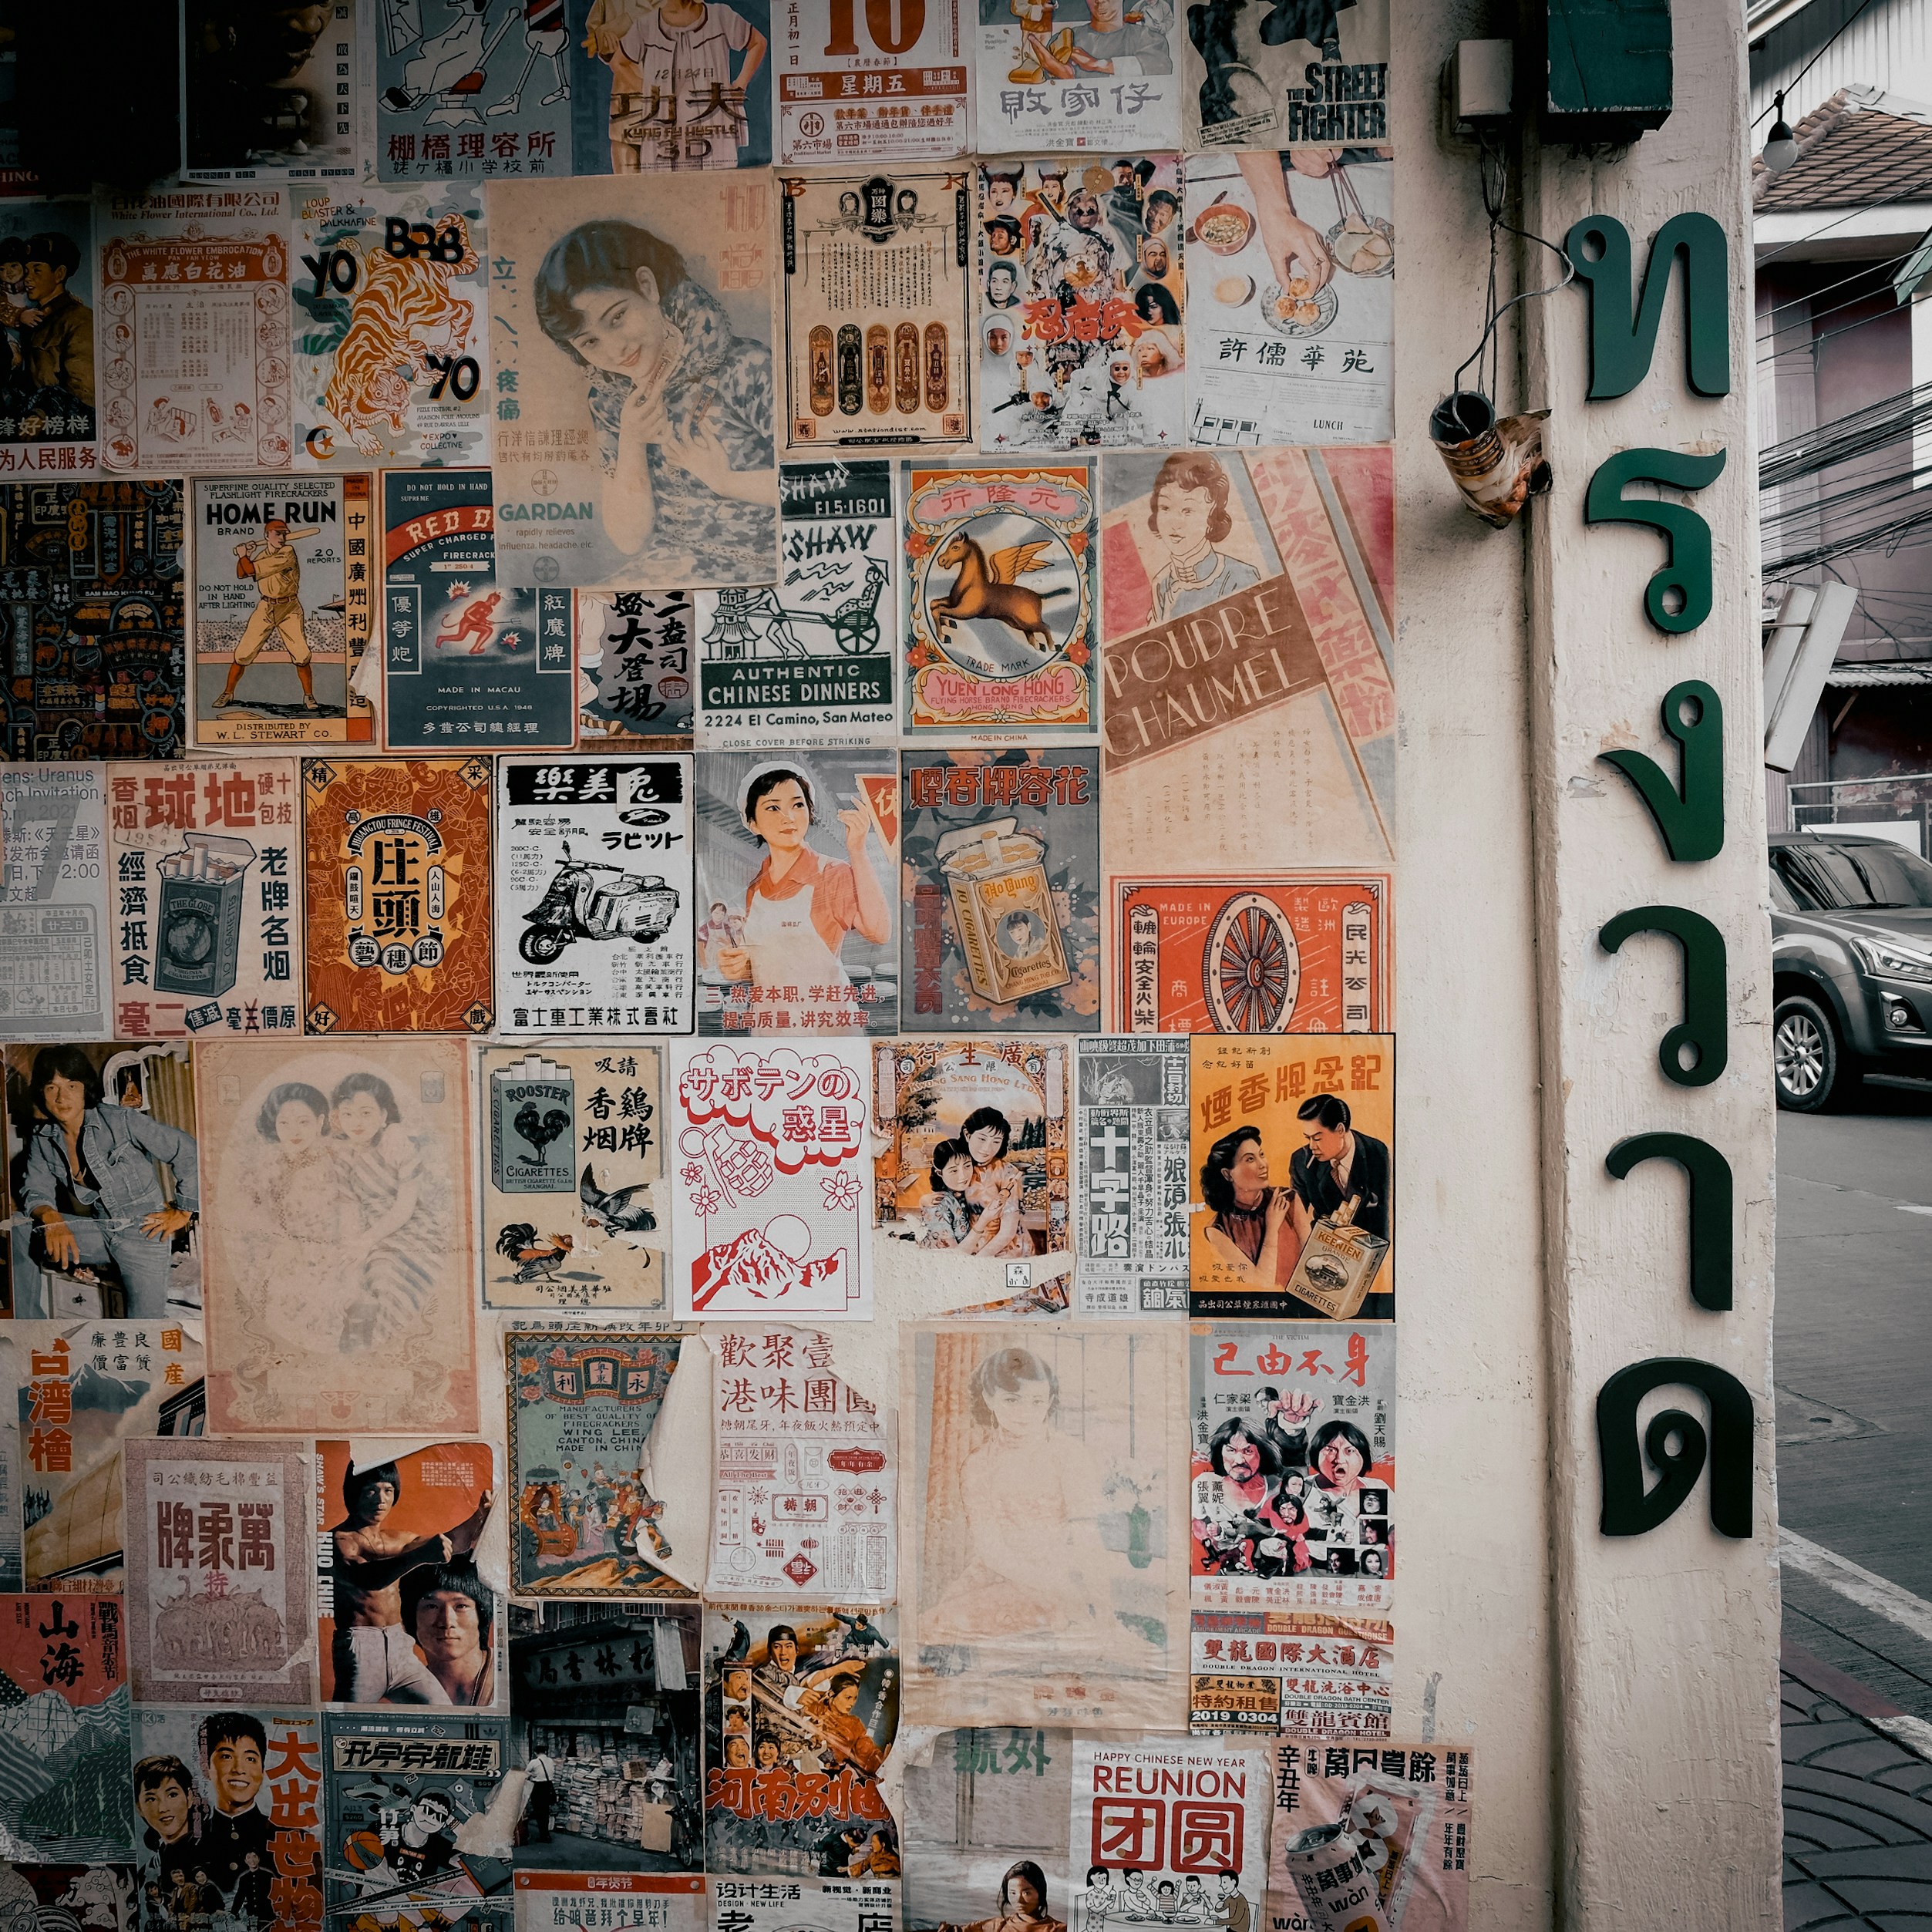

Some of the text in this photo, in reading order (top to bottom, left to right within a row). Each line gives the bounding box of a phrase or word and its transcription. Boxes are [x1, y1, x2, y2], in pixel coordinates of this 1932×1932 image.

[787, 2, 799, 66] 正月初一日
[840, 75, 906, 96] 星期五
[1287, 62, 1388, 103] THE STREET
[610, 82, 752, 126] 功夫
[624, 124, 740, 140] KUNG FU HUSTLE
[1288, 102, 1386, 142] FIGHTER
[388, 131, 557, 160] 棚橋理容所
[656, 139, 713, 160] 3D
[793, 138, 833, 150] 第六市場
[306, 197, 330, 209] LOUP
[385, 217, 463, 264] BBB
[126, 248, 141, 260] THE
[206, 247, 263, 256] EMBROCATION
[300, 249, 358, 299] YO
[425, 353, 482, 403] YO
[1314, 419, 1343, 430] LUNCH
[420, 441, 463, 449] COLLECTIVE
[207, 501, 336, 525] HOME RUN
[498, 502, 593, 521] GARDAN
[217, 527, 254, 536] BRAND
[516, 527, 574, 537] rapidly relieves
[403, 533, 487, 562] SUPER CHARGED
[1103, 586, 1292, 699] POUDRE
[732, 665, 860, 680] AUTHENTIC
[965, 655, 1032, 672] TRADE MARK
[708, 682, 880, 704] CHINESE DINNERS
[936, 675, 1065, 697] YUEN LONG HONG
[1104, 647, 1311, 757] CHAUMEL
[705, 712, 893, 727] 2224 El Camino, San Mateo
[789, 738, 826, 746] BEFORE
[39, 769, 94, 782] Uranus
[311, 764, 483, 784] 精 采
[387, 818, 412, 829] FRINGE
[412, 822, 441, 848] FESTIVAL
[601, 831, 684, 850] ラビット
[1563, 212, 1753, 1539] ทรงวาด
[372, 837, 421, 939] 庄頭
[430, 870, 441, 914] 人山人海
[170, 900, 214, 913] THE GLOBE
[260, 846, 291, 982] 老牌名烟
[1160, 902, 1211, 912] MADE IN
[116, 851, 151, 986] 經濟抵食
[1163, 916, 1207, 925] EUROPE
[957, 888, 988, 988] 10 CIGARETTES
[1009, 958, 1052, 978] Cigarettes
[513, 1007, 678, 1027] 富士重工業株式會社
[688, 1066, 852, 1102] サボテンの
[907, 1076, 947, 1092] KWONG
[950, 1073, 977, 1083] SANG
[981, 1074, 1010, 1085] HONG
[505, 1085, 571, 1106] ROOSTER
[782, 1106, 852, 1143] 惑星
[1090, 1126, 1130, 1258] 十字路
[1085, 1293, 1129, 1303] 娘道成寺
[1294, 1284, 1337, 1311] CIGARETTES
[556, 1374, 576, 1393] 利
[628, 1375, 646, 1393] 永
[1197, 1410, 1209, 1445] 洪金寶
[315, 1452, 325, 1493] SHAW'S
[783, 1498, 818, 1512] 糖朝
[39, 1600, 84, 1687] 山海
[1203, 1639, 1380, 1669] 雙龍國際大酒店
[1192, 1711, 1277, 1722] 2019 0304
[1094, 1751, 1247, 1769] HAPPY CHINESE NEW YEAR
[1092, 1765, 1247, 1799] REUNION
[1277, 1745, 1301, 1813] 辛丑年
[1090, 1796, 1246, 1876] 团圆
[716, 1883, 800, 1900] 设计生活
